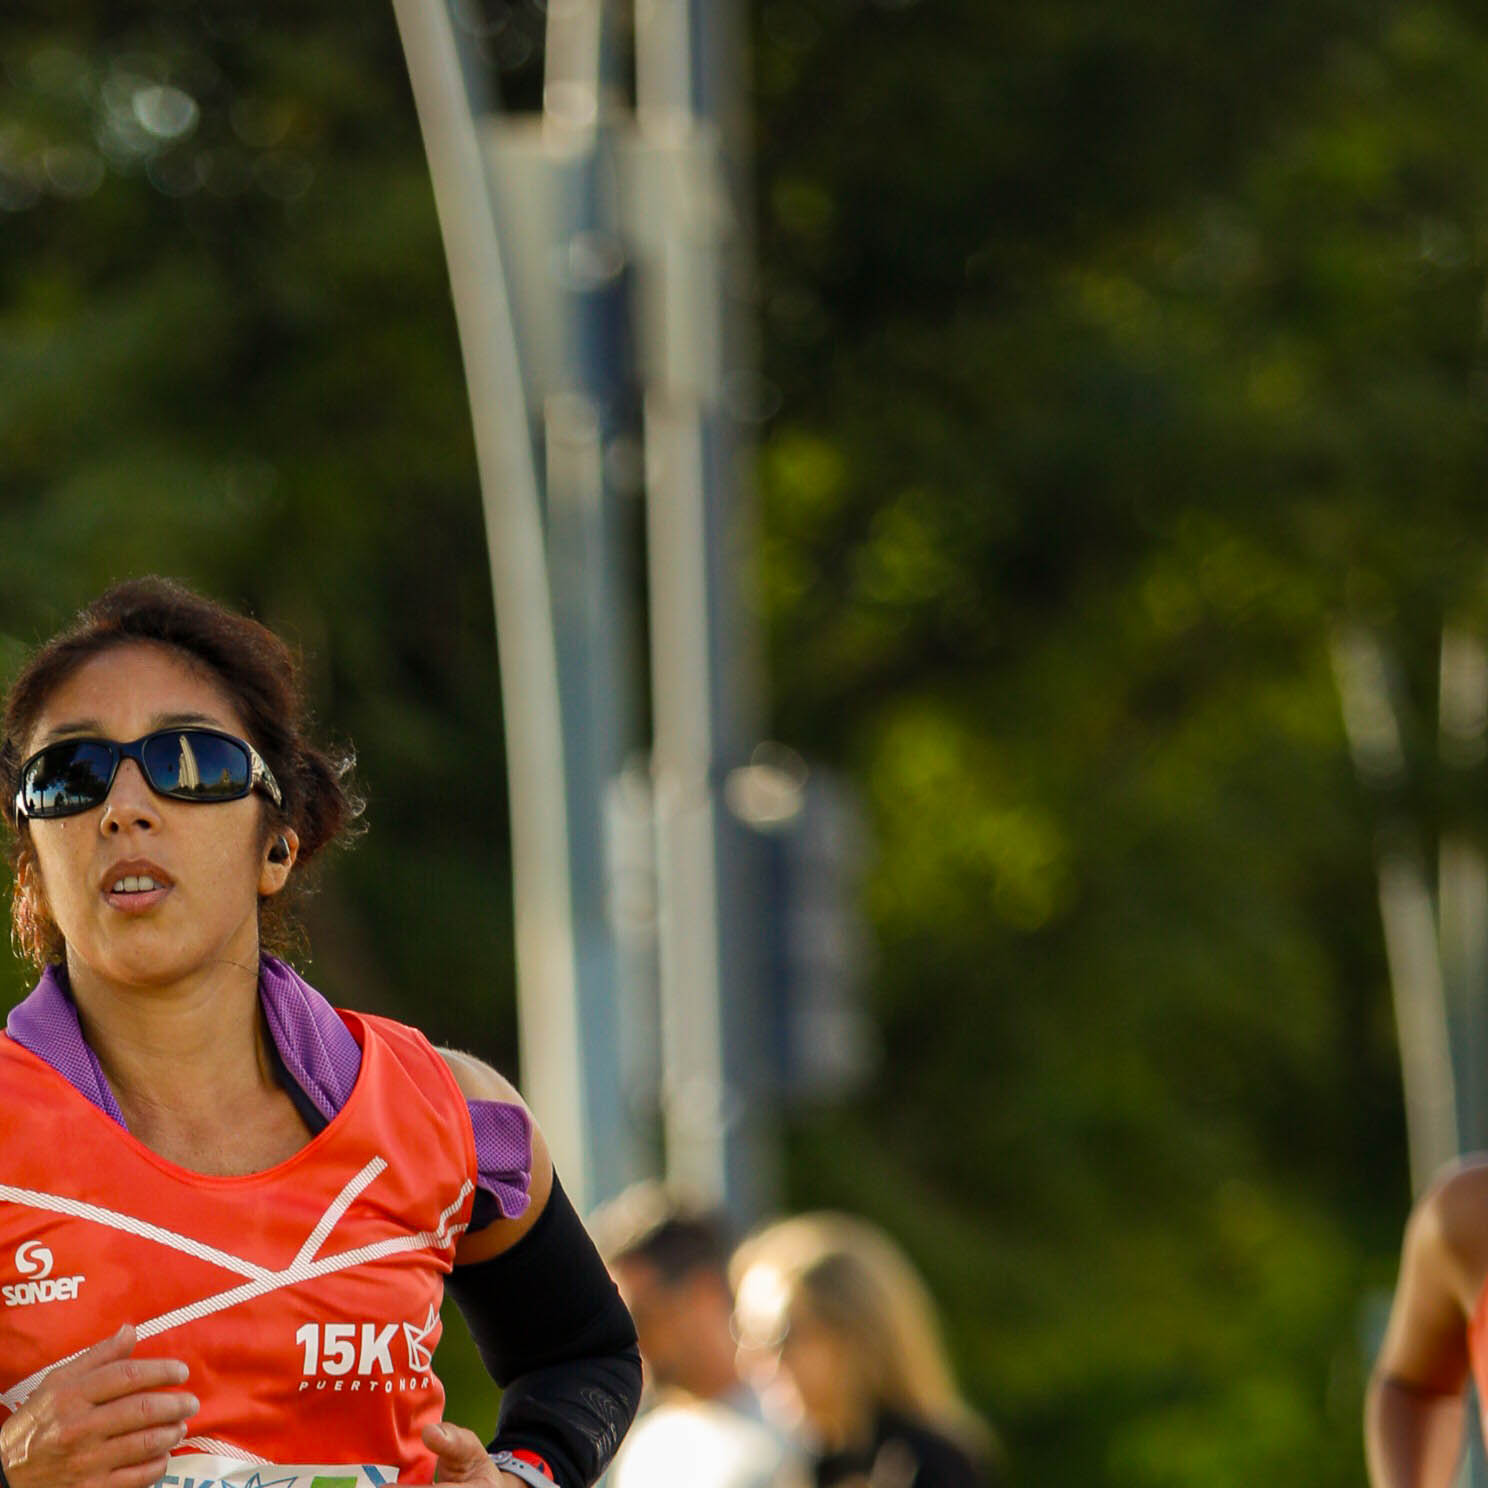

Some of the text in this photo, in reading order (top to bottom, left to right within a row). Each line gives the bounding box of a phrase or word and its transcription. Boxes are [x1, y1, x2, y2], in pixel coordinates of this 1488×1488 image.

[296, 1323, 400, 1376] 15K
[298, 1376, 434, 1394] PUERTO NOR
